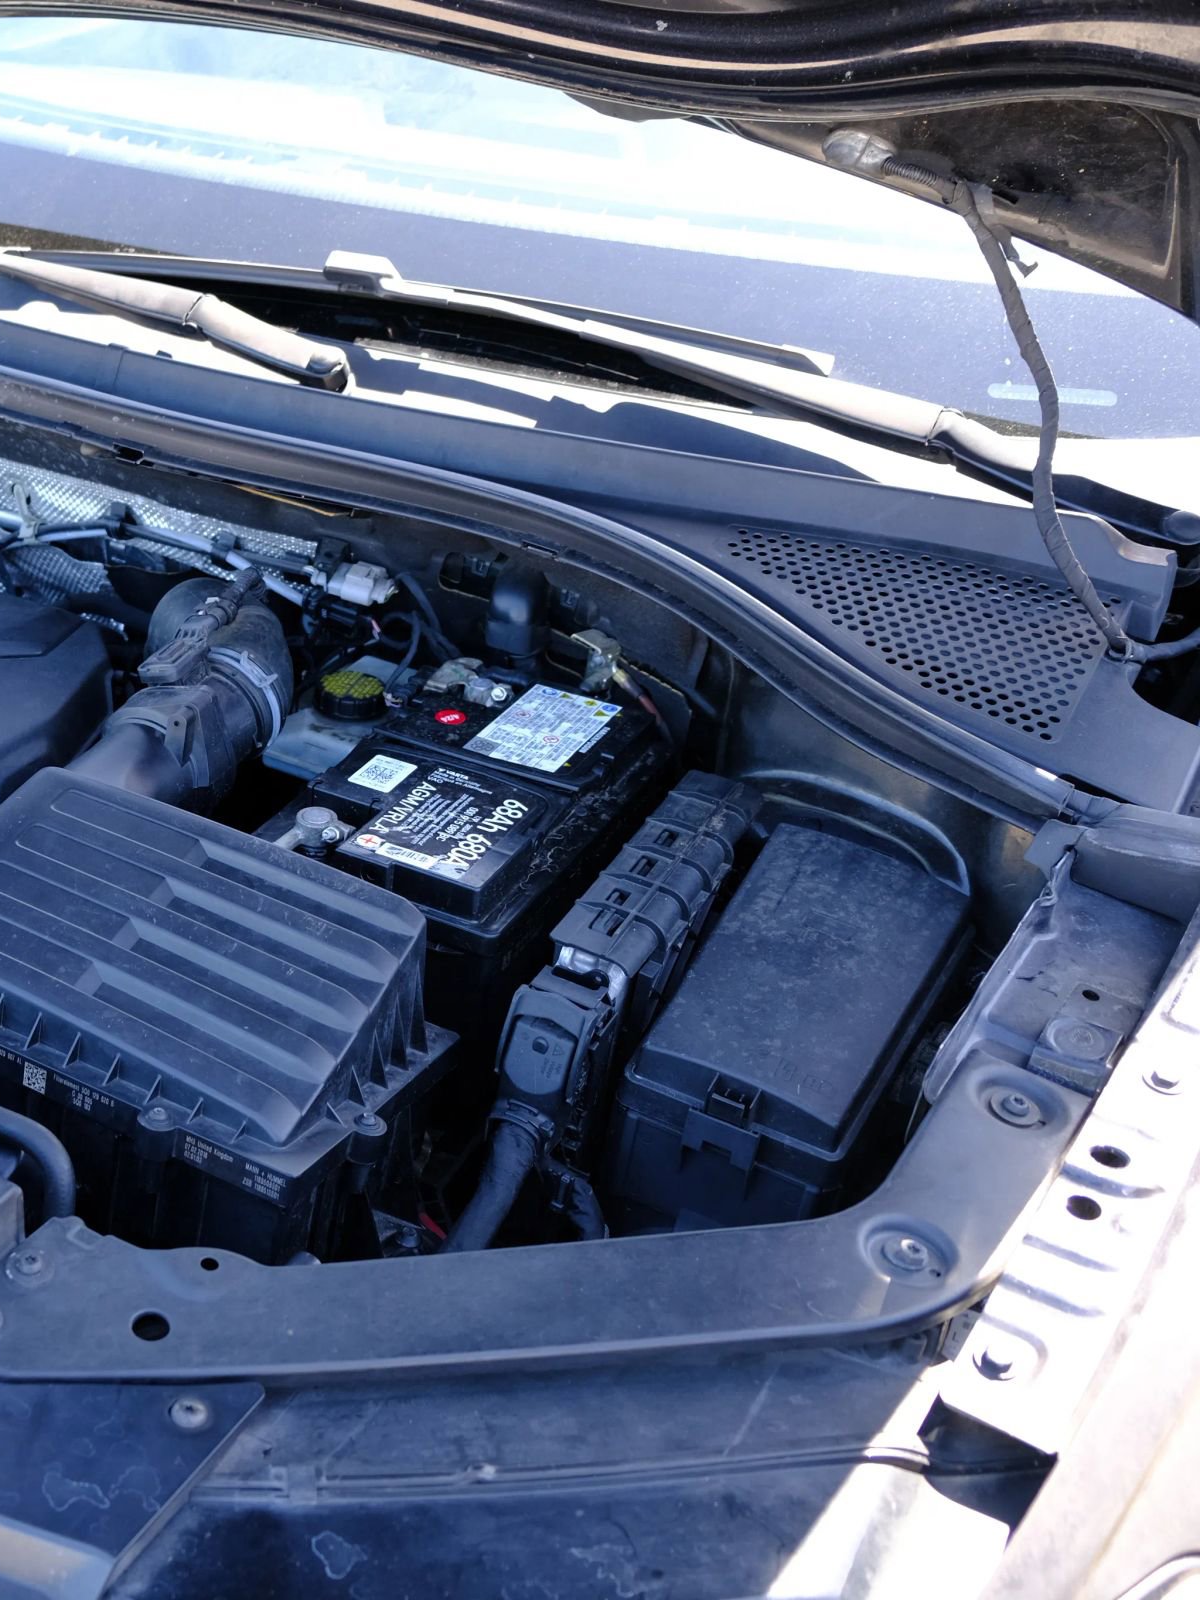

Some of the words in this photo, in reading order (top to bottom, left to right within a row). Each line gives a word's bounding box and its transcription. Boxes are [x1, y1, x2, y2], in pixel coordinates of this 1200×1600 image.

[446, 770, 470, 780] VARTA
[369, 781, 437, 834] AGM/VRLA
[477, 799, 529, 833] 68Ah
[447, 833, 492, 868] 680A
[197, 1140, 212, 1154] United
[214, 1147, 234, 1163] Kingdom
[245, 1162, 259, 1174] MANN
